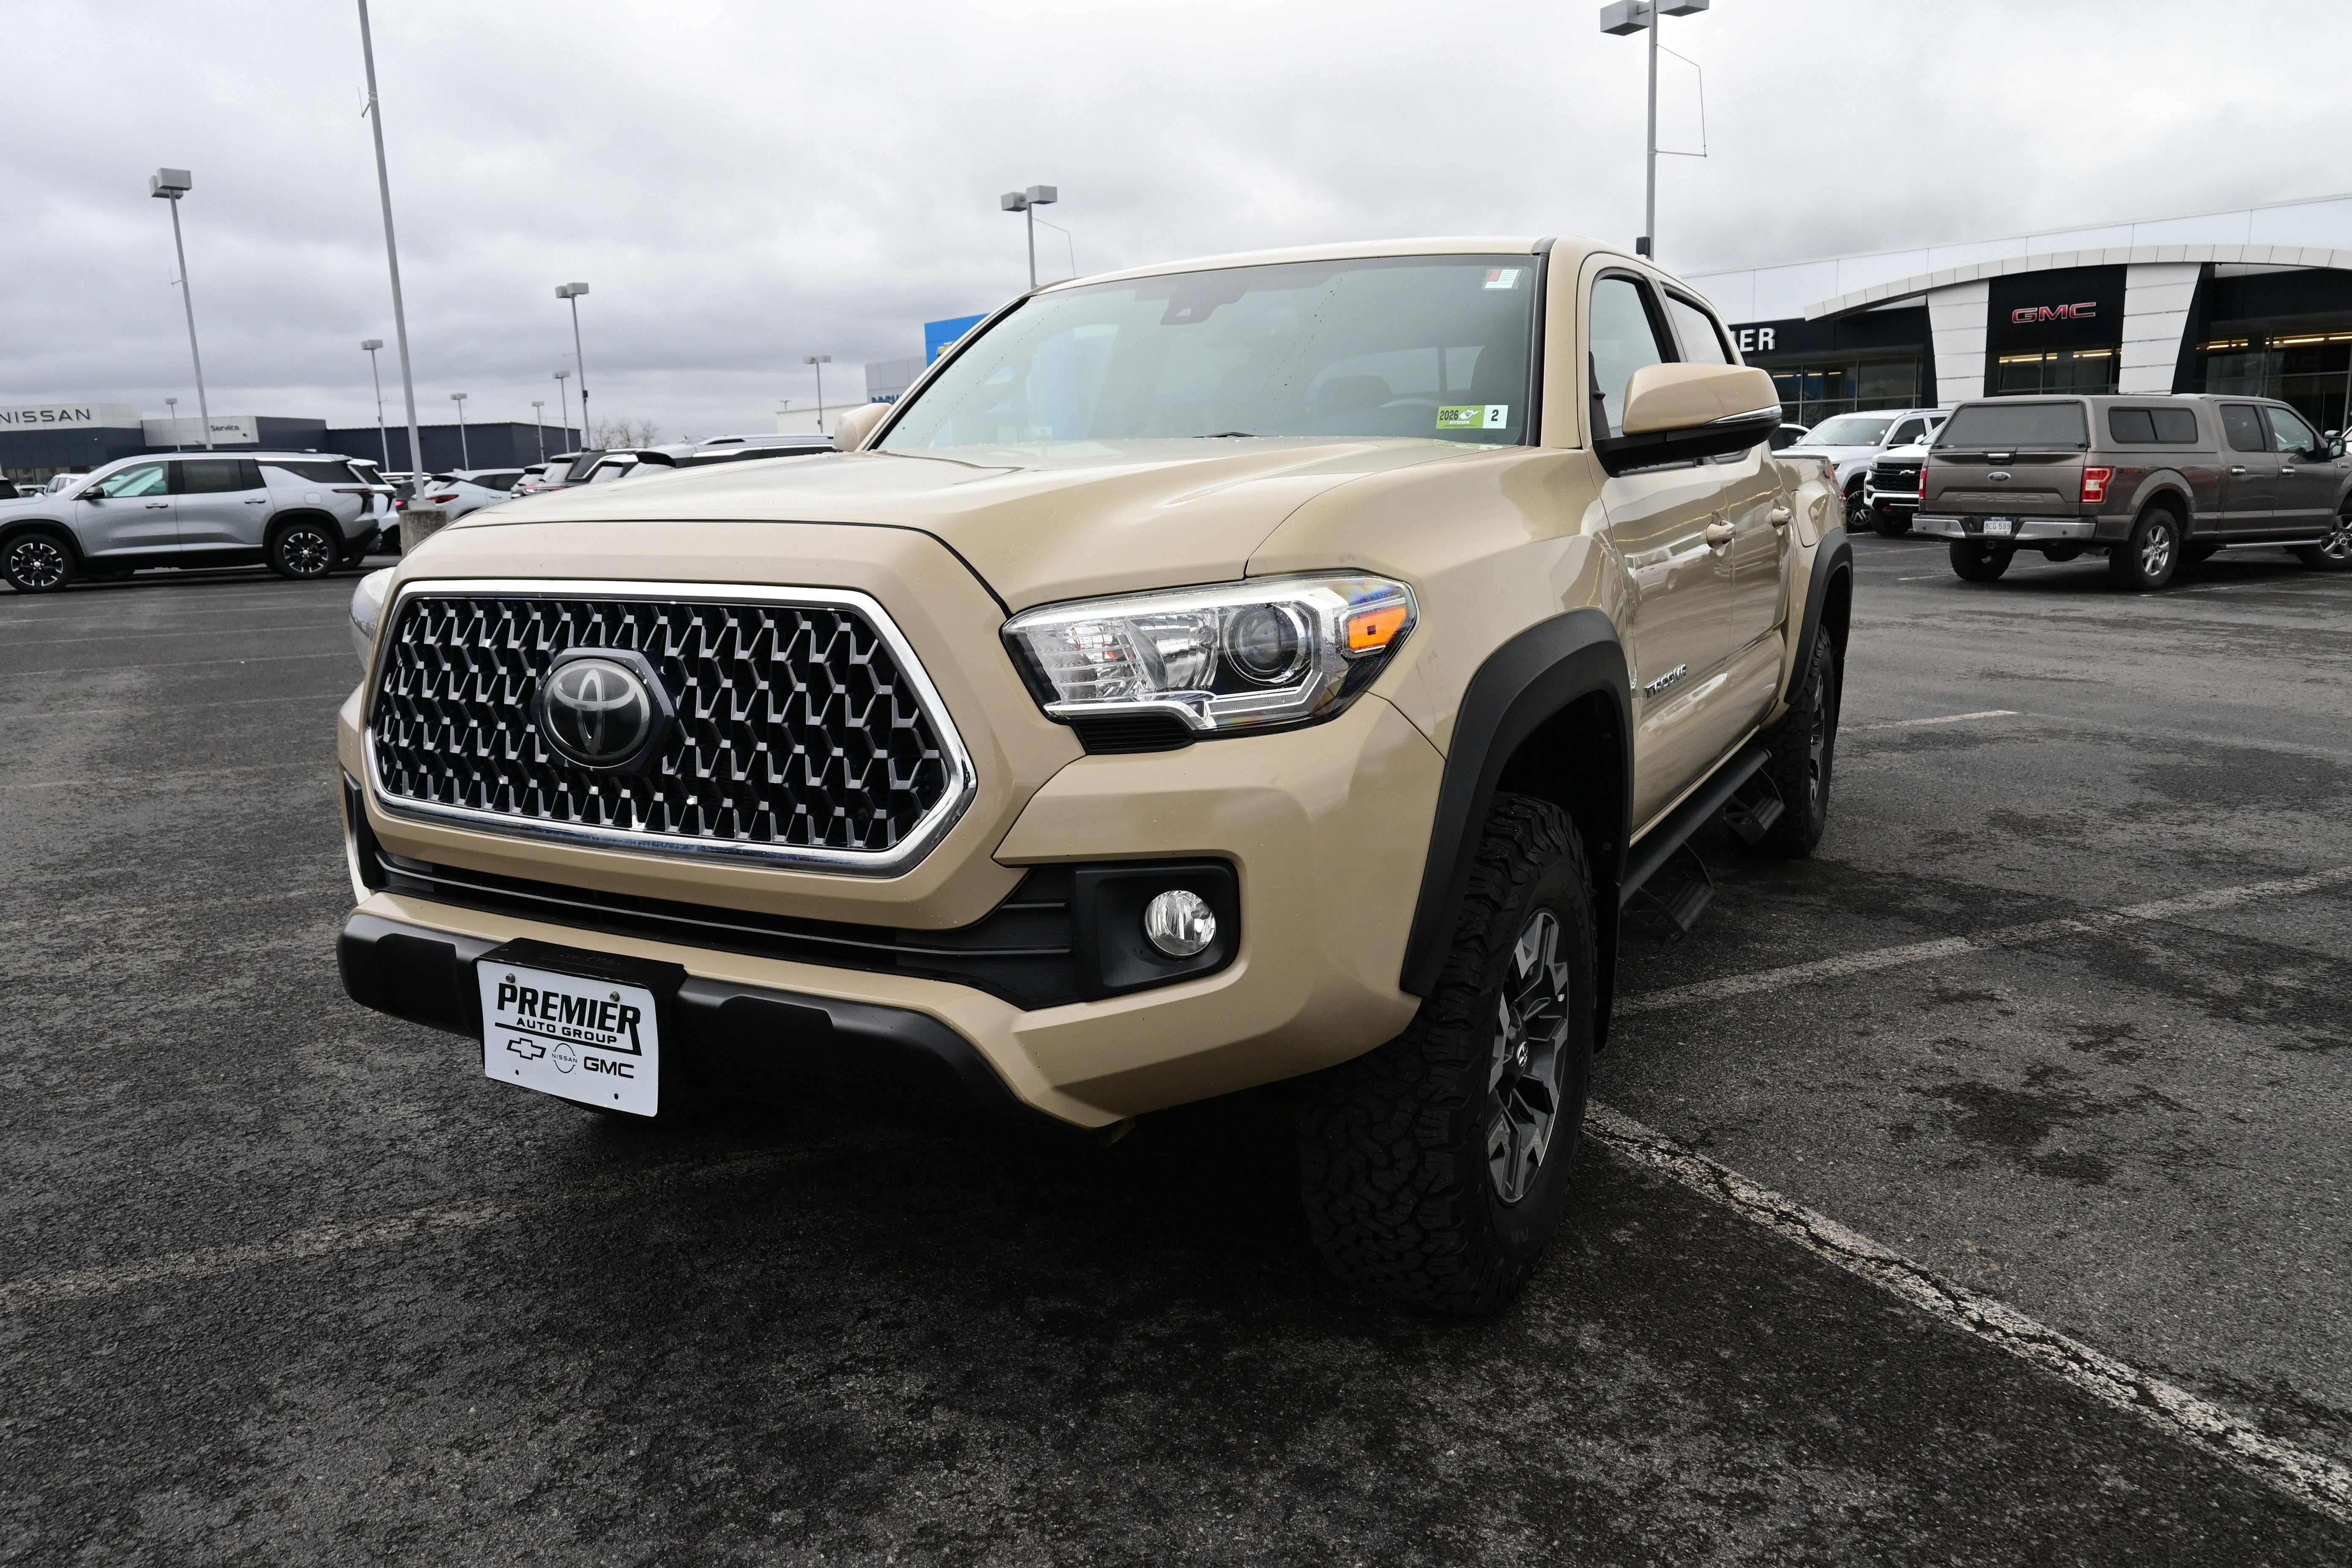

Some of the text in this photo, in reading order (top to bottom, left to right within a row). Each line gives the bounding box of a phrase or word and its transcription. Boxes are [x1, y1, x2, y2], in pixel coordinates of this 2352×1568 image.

[2012, 302, 2096, 324] GMC
[0, 408, 90, 424] NISSAN
[1439, 410, 1459, 421] 2026
[1491, 409, 1499, 422] 2
[497, 983, 642, 1056] PREMIER
[517, 1017, 617, 1044] AUTO GROUP
[552, 1053, 577, 1063] NISSAN
[584, 1056, 634, 1079] GMC
